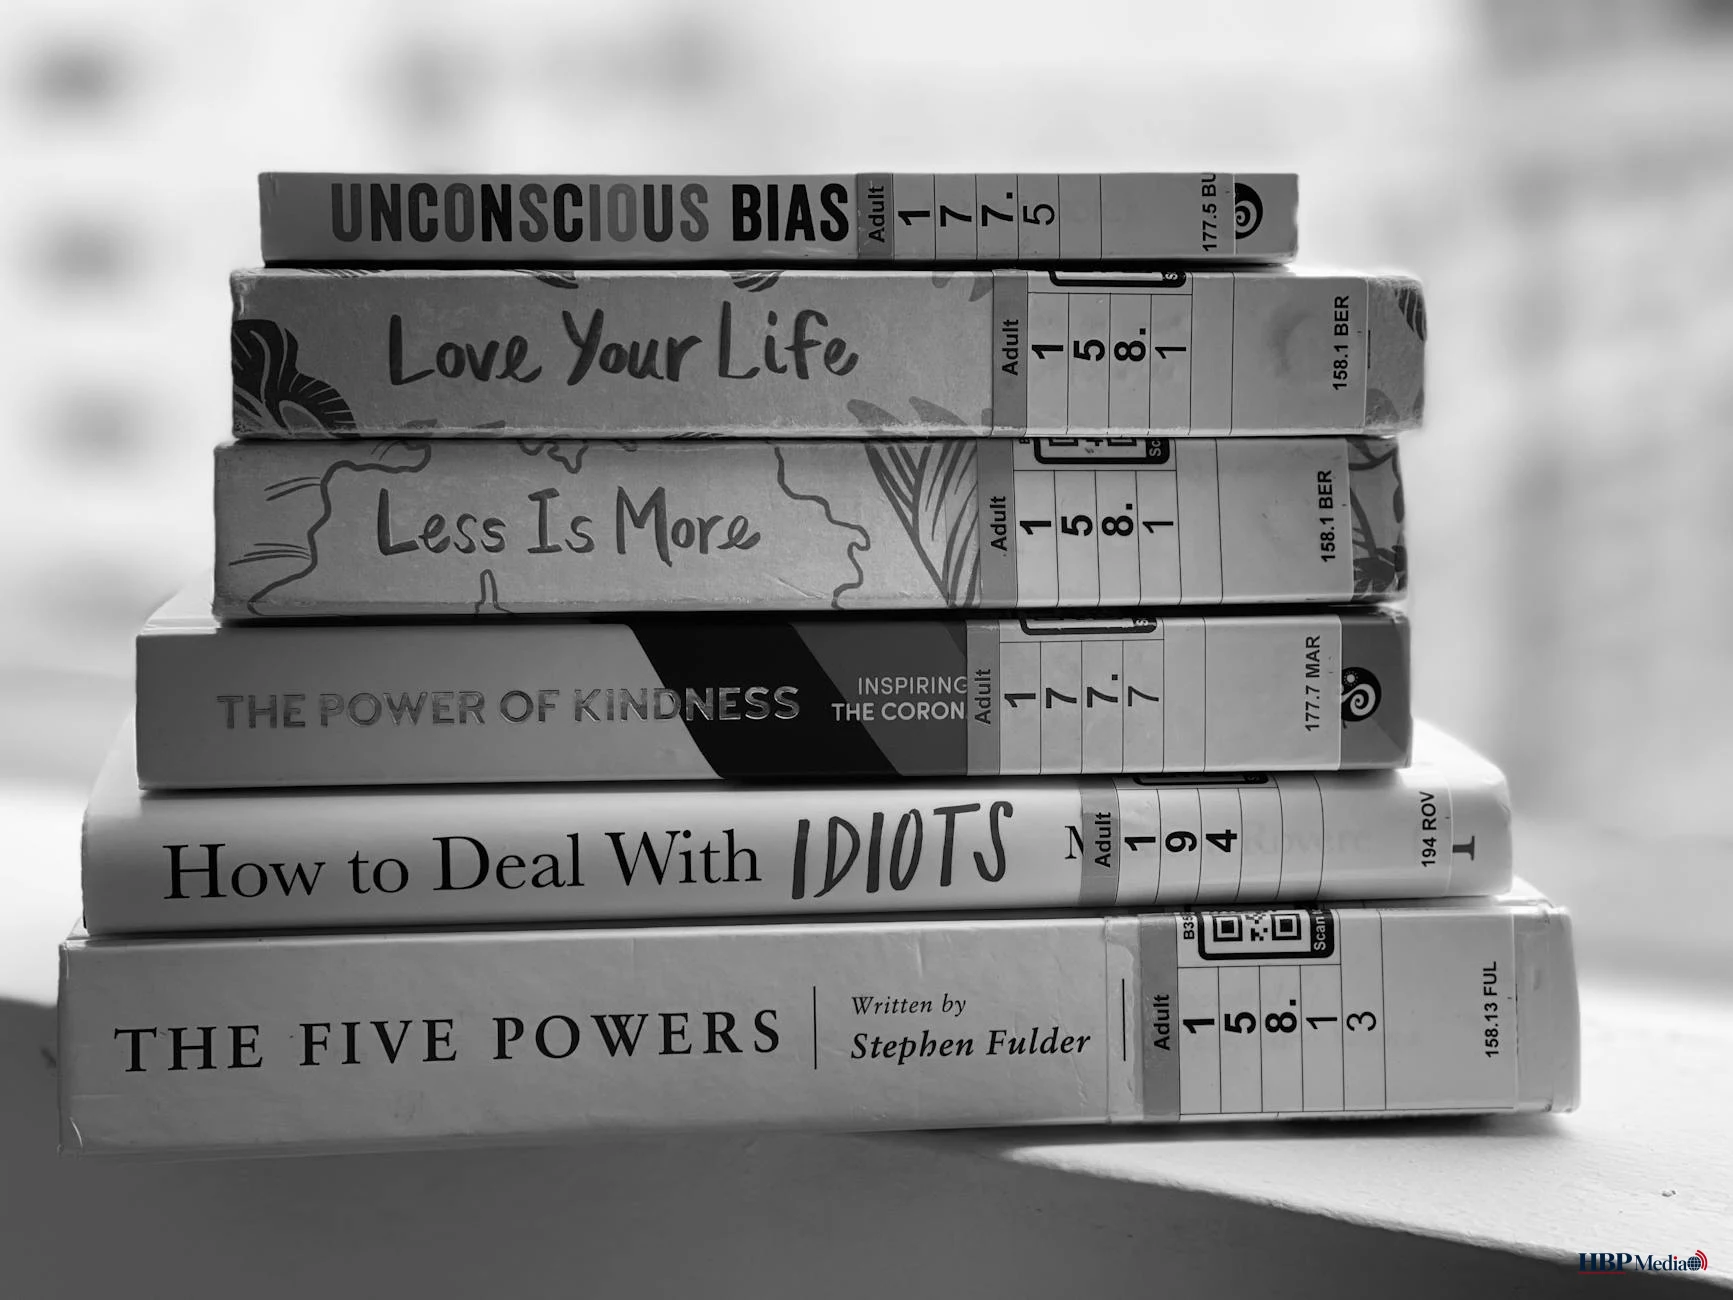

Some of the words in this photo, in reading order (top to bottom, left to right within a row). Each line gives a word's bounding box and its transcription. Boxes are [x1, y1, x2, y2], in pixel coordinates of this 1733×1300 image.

[330, 182, 708, 243] UNCONSCIOUS
[731, 182, 850, 242] BIAS
[867, 185, 885, 243] Adult
[1202, 203, 1217, 252] 177.5
[1334, 295, 1349, 336] BER
[388, 314, 542, 386] Love
[562, 308, 703, 386] Your
[718, 300, 859, 381] Life
[1001, 319, 1019, 376] Adult
[1332, 345, 1348, 390] 158.1
[1317, 470, 1333, 509] BER
[376, 488, 507, 556] Less
[528, 488, 595, 554] Is
[617, 486, 761, 568] More
[990, 496, 1008, 551] Adult
[1320, 517, 1336, 563] 158.1
[1305, 635, 1321, 678] MAR
[217, 694, 306, 730] THE
[320, 690, 485, 728] POWER
[500, 688, 559, 723] OF
[574, 685, 800, 722] KINDNESS
[858, 676, 967, 696] INSPIRING
[974, 668, 992, 725] Adult
[1305, 685, 1320, 731] 177.7
[831, 702, 875, 721] THE
[881, 701, 968, 721] CORON
[1419, 791, 1437, 831] ROV
[163, 842, 326, 900] How
[348, 850, 409, 894] to
[433, 832, 585, 892] Deal
[605, 829, 762, 886] With
[791, 801, 1014, 900] IDIOTS
[1094, 812, 1111, 868] Adult
[1421, 837, 1437, 867] 194
[1483, 960, 1498, 996] FUL
[851, 995, 933, 1016] Written
[941, 993, 966, 1017] by
[1153, 994, 1170, 1051] Adult
[115, 1026, 263, 1073] THE
[299, 1018, 458, 1066] FIVE
[493, 1008, 781, 1061] POWERS
[851, 1029, 974, 1065] Stephen
[985, 1026, 1091, 1056] Fulder
[1484, 1002, 1499, 1058] 158.13
